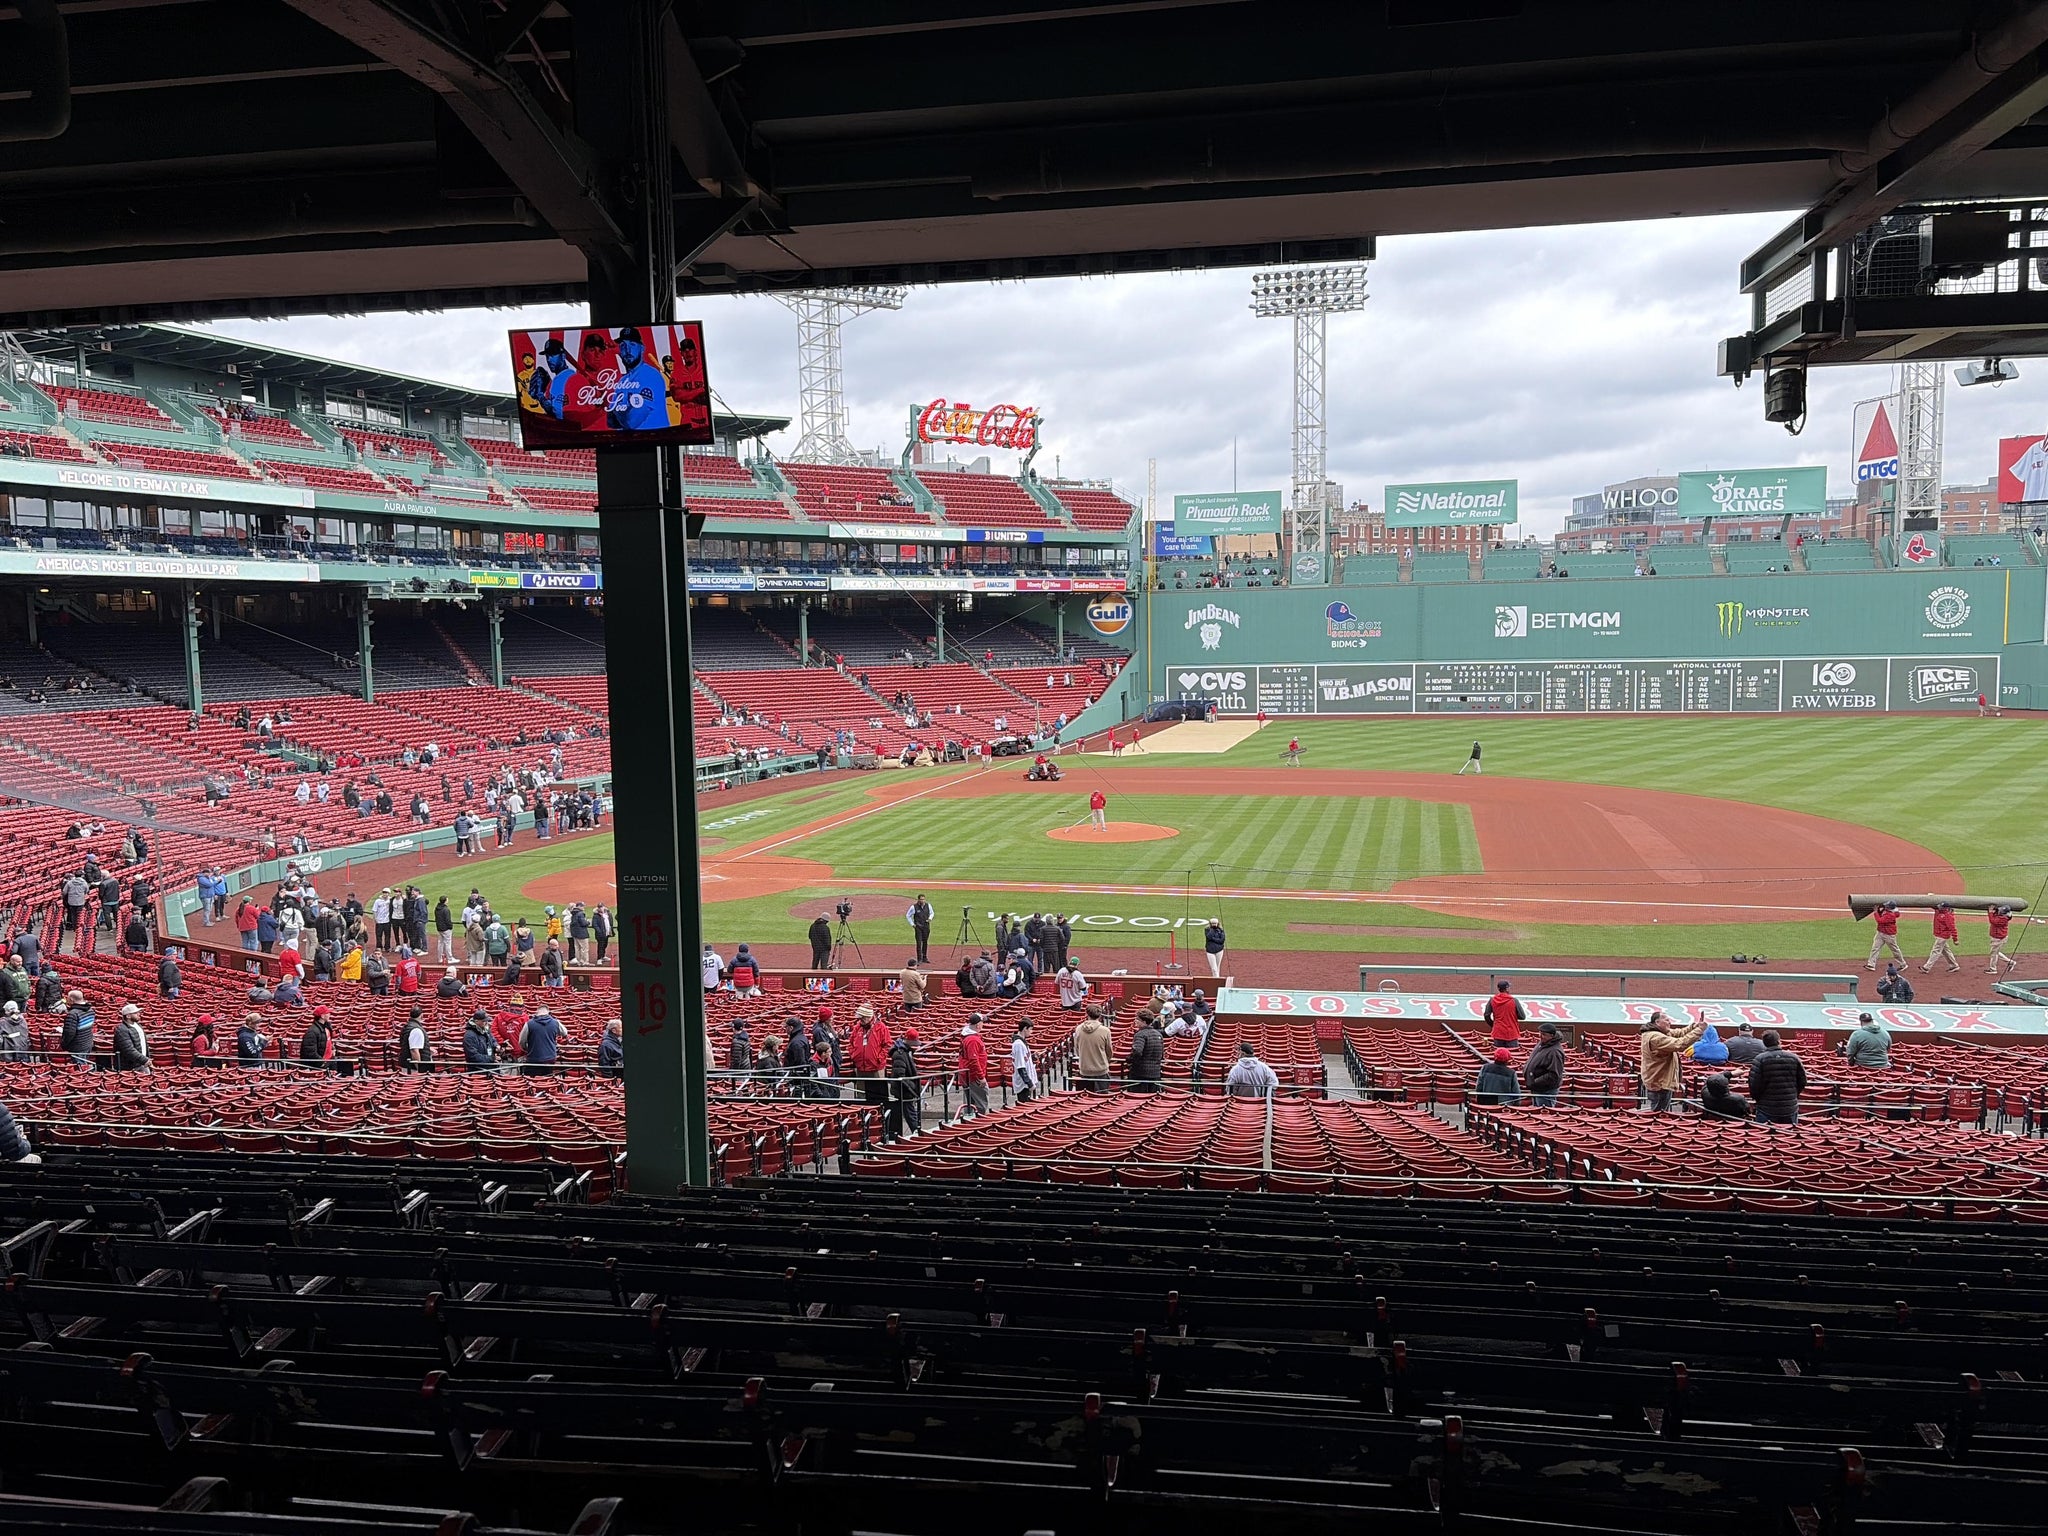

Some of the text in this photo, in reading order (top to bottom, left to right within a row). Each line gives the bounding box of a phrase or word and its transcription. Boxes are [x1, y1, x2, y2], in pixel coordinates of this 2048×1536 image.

[594, 369, 640, 391] Boston
[577, 386, 604, 406] Red
[604, 392, 628, 412] Sox
[1858, 459, 1898, 480] CITGO
[58, 470, 209, 495] WELCOME TO FENWAY PARK
[1421, 490, 1505, 510] National
[1712, 486, 1787, 503] DRAFT
[384, 501, 436, 514] AURA PAVILION
[1186, 503, 1270, 519] Plymouth Rock
[1469, 509, 1501, 517] Rental
[1722, 499, 1784, 512] KINGS
[926, 530, 943, 538] PARK
[994, 532, 1027, 540] UNITED
[36, 558, 238, 575] AMERICA'S MOST BELOVED BALLPARK
[471, 573, 498, 585] SULLIVAN
[549, 576, 581, 586] HYCU
[1928, 586, 1968, 600] IBEW 103
[1089, 606, 1128, 619] Gulf
[1185, 604, 1240, 630] JIM BEAM
[1532, 612, 1620, 628] BETMGM
[1746, 608, 1809, 618] MONSTER
[1332, 622, 1355, 630] RED
[1200, 672, 1246, 690] CVS
[1813, 662, 1856, 686] 160
[1923, 668, 1970, 685] ACE
[1923, 683, 1970, 695] TICKET
[2003, 686, 2018, 694] 379
[1792, 696, 1876, 708] F.W. WEBB
[632, 915, 665, 954] 15
[703, 959, 714, 968] 42
[1061, 979, 1073, 988] 50
[634, 982, 666, 1021] 16
[1622, 1002, 1791, 1026] RED
[1822, 1007, 2016, 1031] SOX
